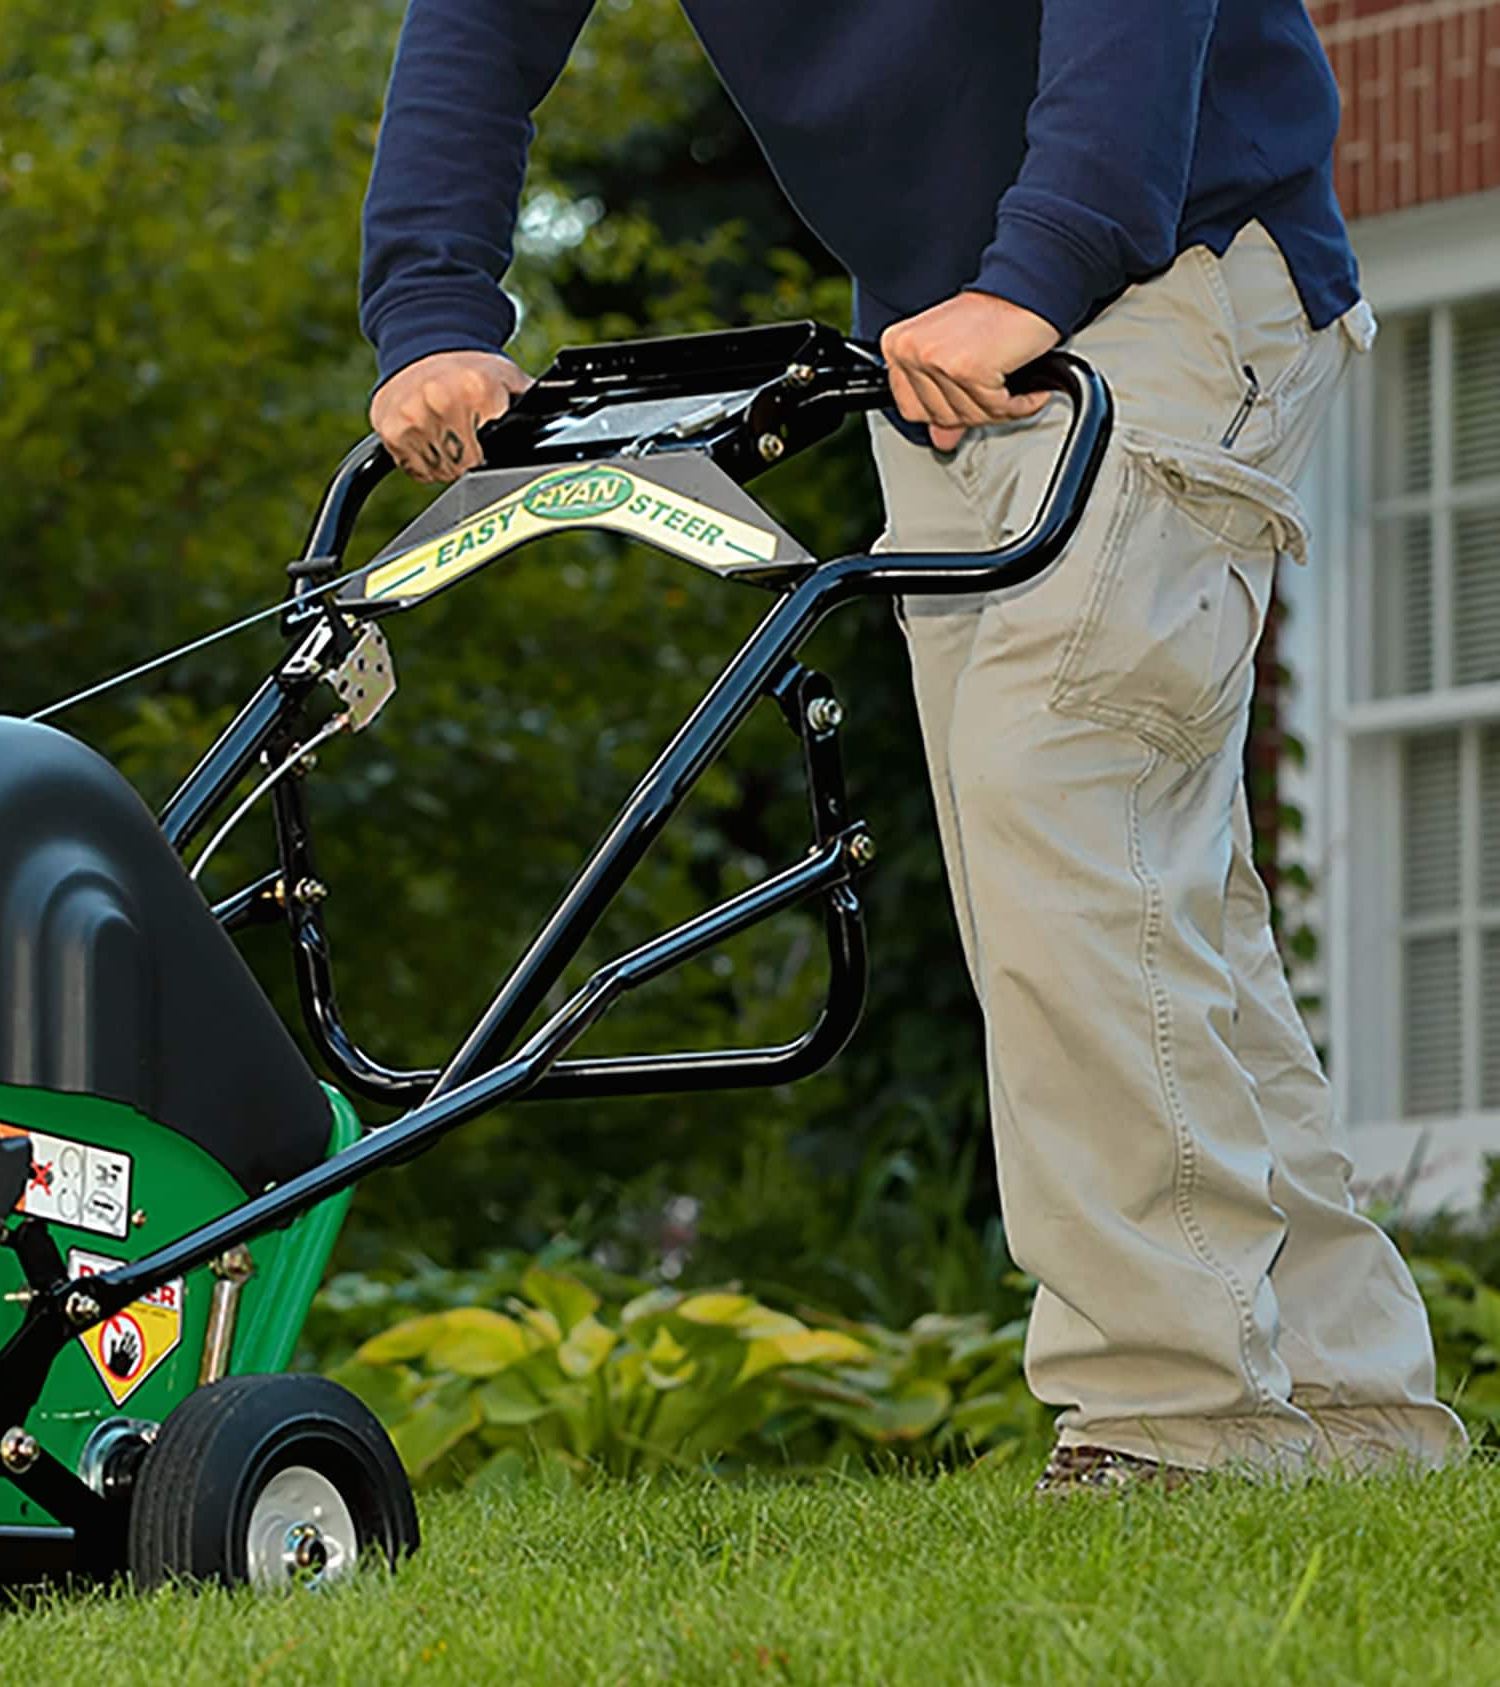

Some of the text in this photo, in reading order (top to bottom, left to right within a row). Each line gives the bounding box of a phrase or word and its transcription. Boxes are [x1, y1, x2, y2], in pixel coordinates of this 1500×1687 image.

[434, 479, 725, 569] EASY RYAN STEER
